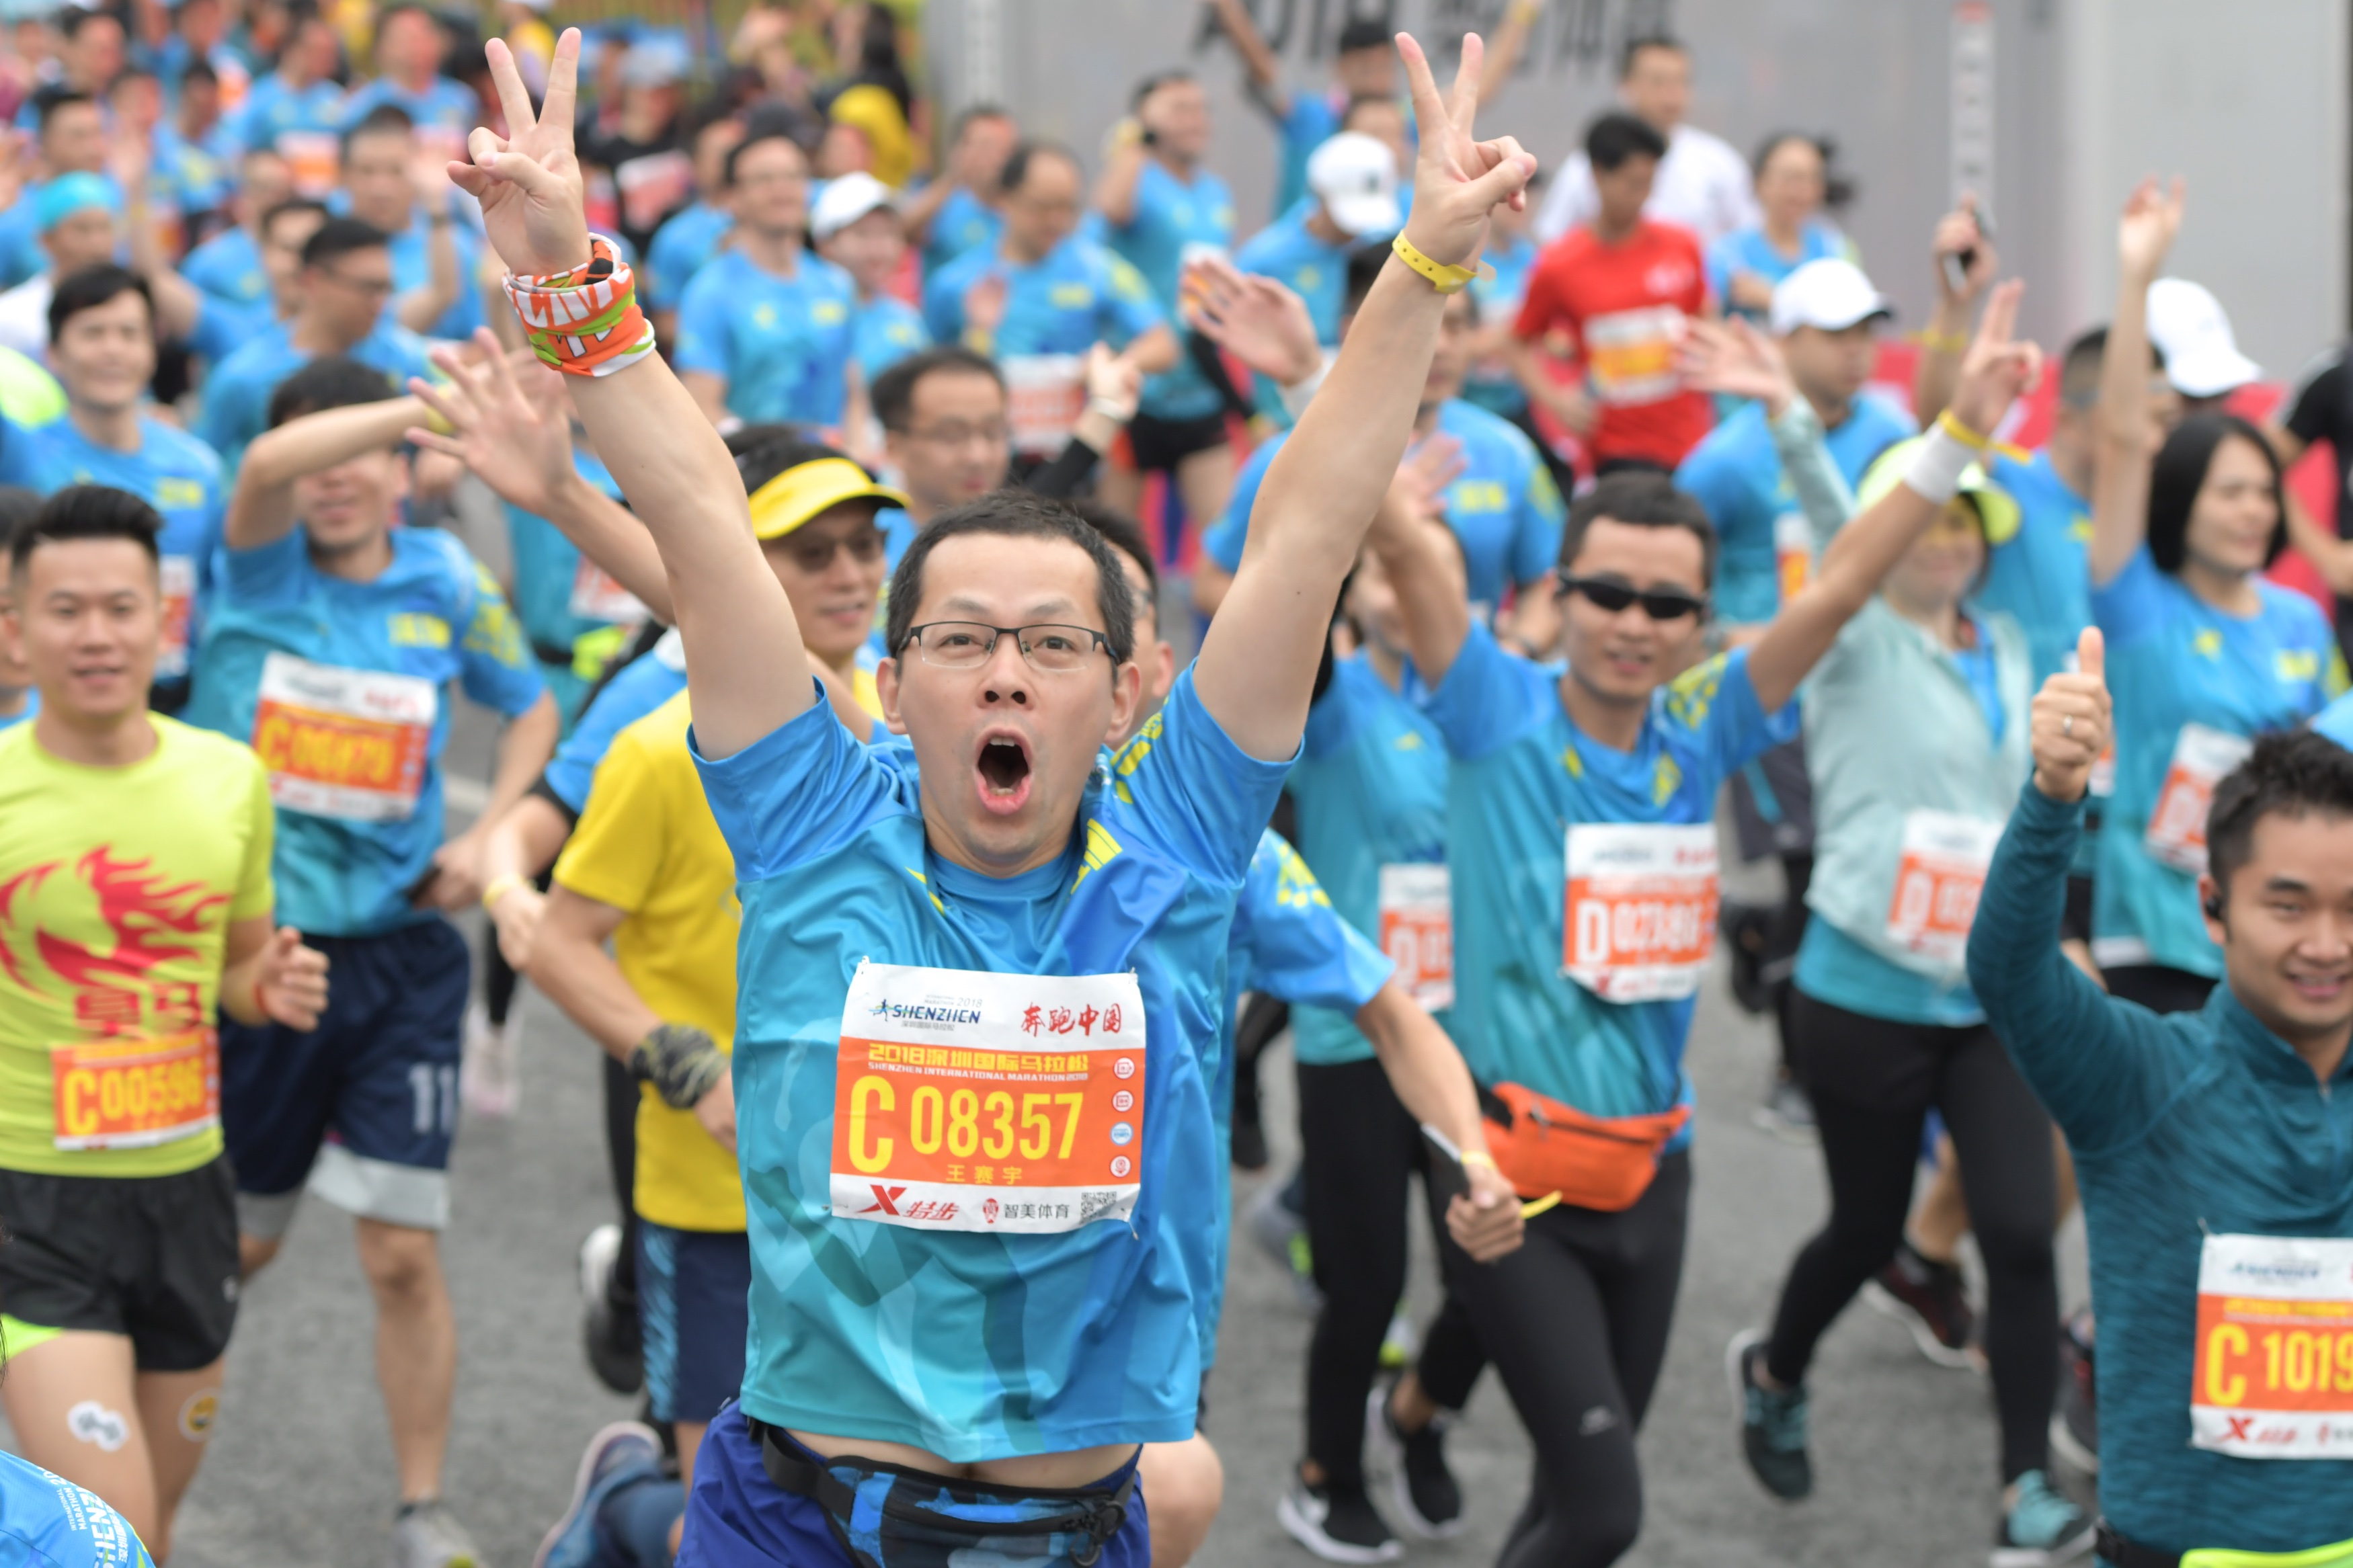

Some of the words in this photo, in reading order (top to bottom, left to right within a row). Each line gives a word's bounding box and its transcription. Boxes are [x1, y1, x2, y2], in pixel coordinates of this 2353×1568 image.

[957, 997, 983, 1008] 2018
[868, 1061, 923, 1075] SHENZHEN
[924, 1067, 1006, 1081] INTERNATIONAL
[1007, 1073, 1066, 1082] MARATHON
[1066, 1073, 1088, 1081] 2018
[903, 1200, 960, 1221] 特步
[1004, 1203, 1070, 1220] 智美体育
[56, 1488, 77, 1531] INTERNATIONAL
[63, 1487, 87, 1530] MARATHON
